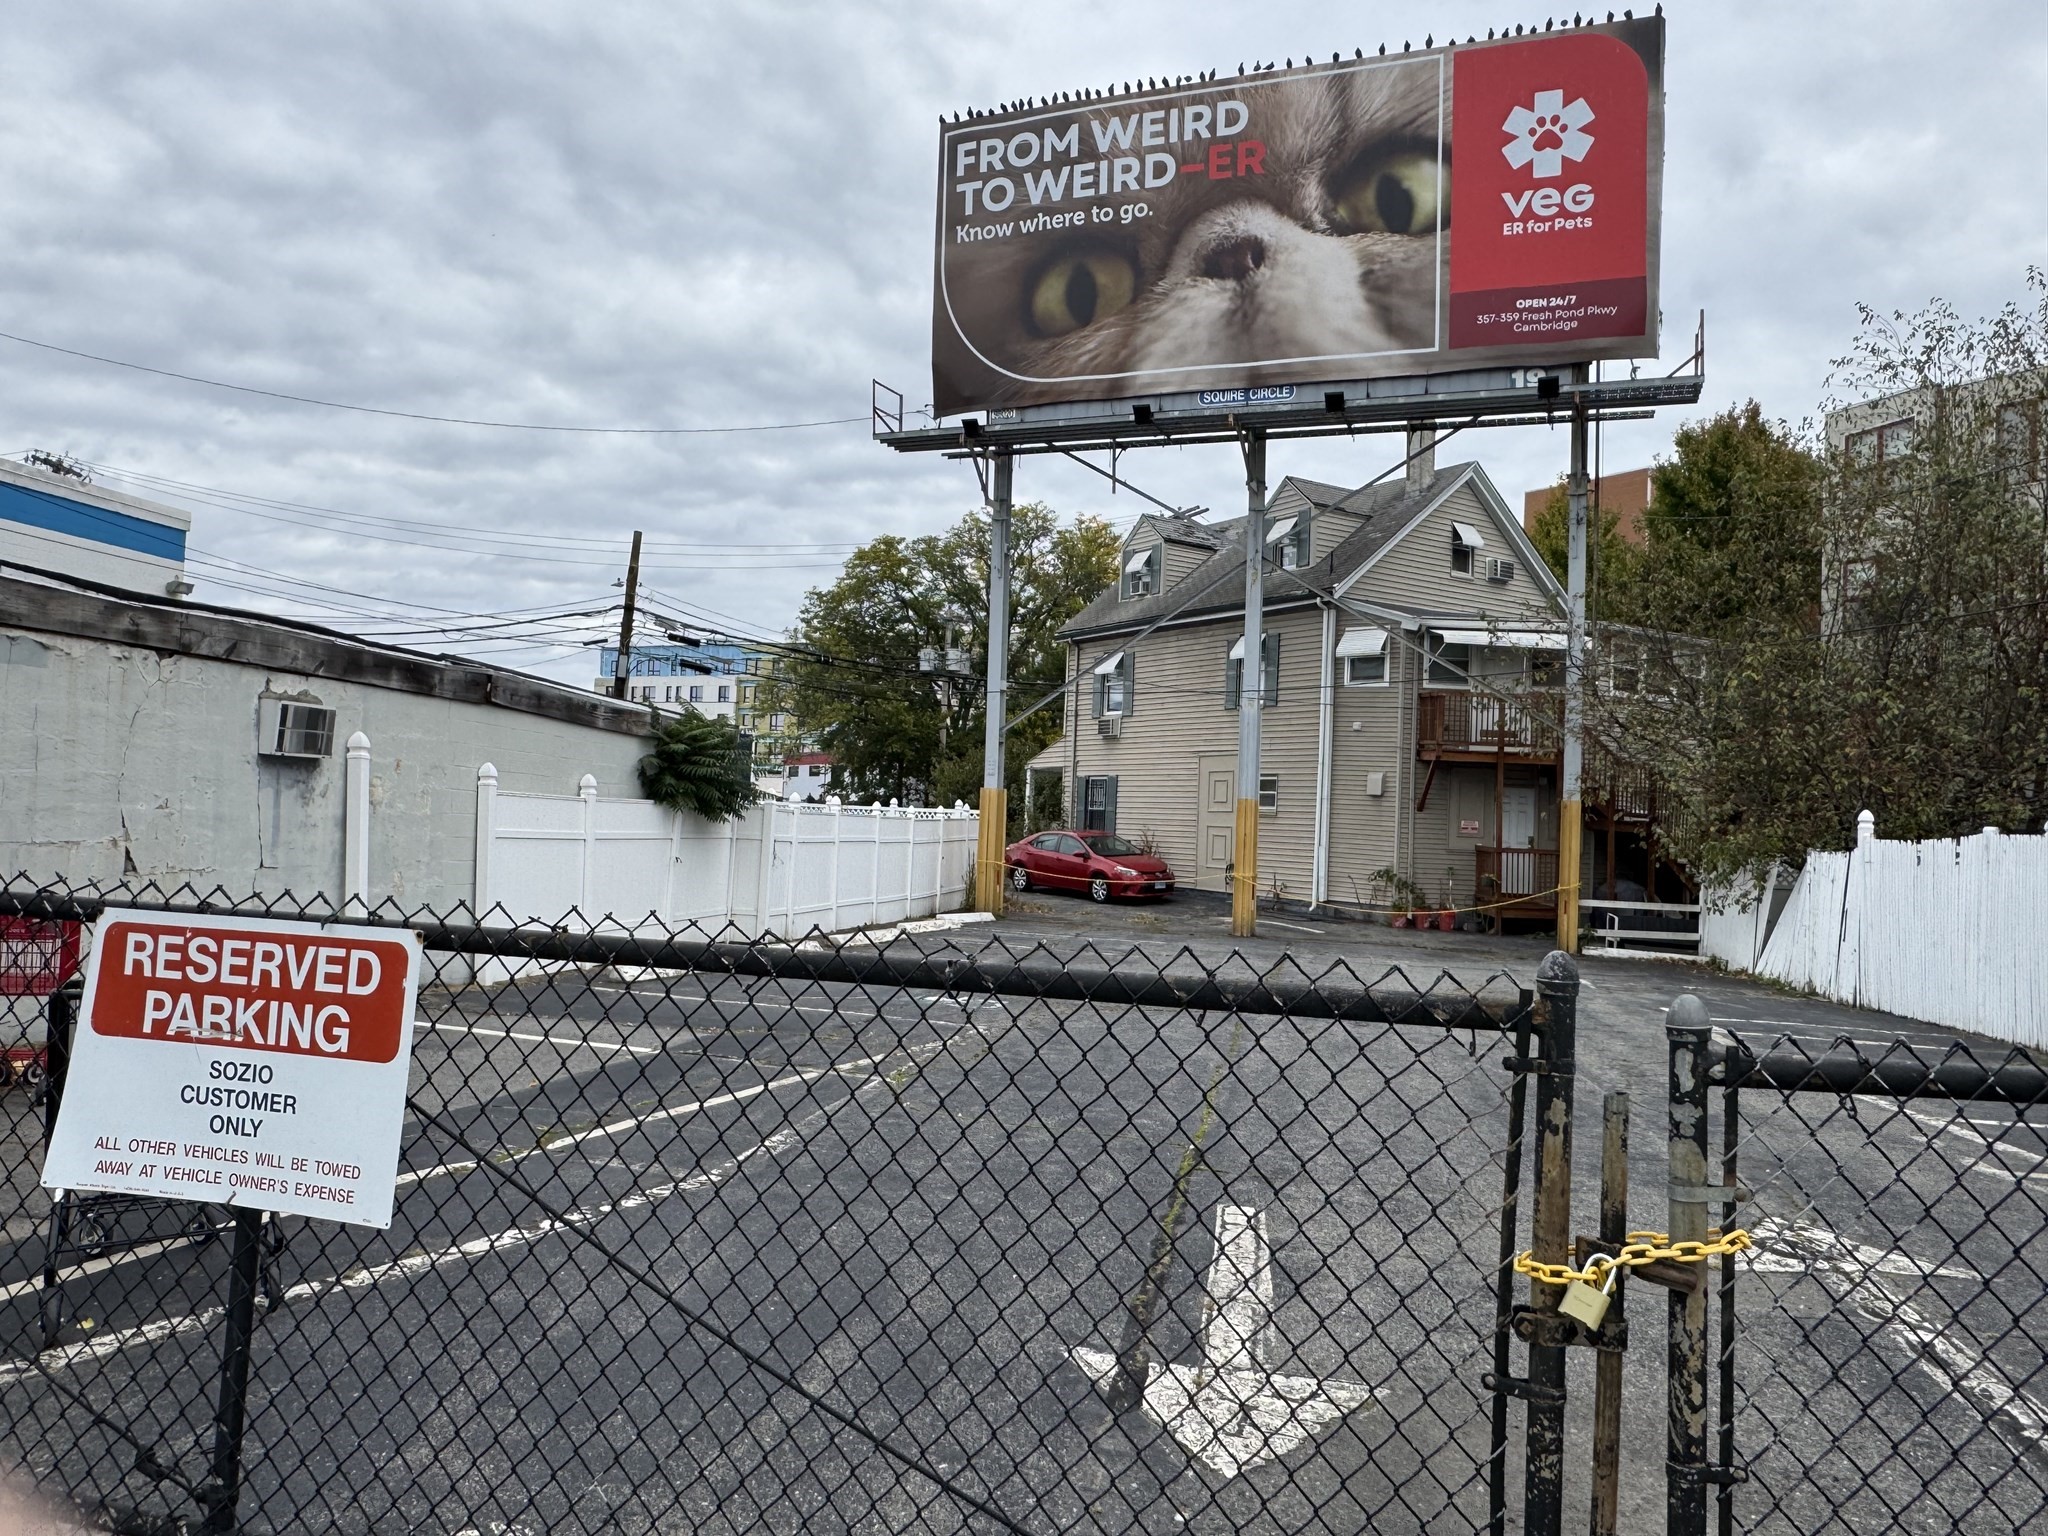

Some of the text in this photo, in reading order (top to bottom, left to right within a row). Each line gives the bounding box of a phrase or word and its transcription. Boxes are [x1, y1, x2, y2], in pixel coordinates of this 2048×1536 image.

[956, 100, 1249, 177] FROM WEIRD
[956, 140, 1267, 215] TO WEIRD-ER
[956, 202, 1153, 243] Know where to go.
[1503, 216, 1593, 235] ER for Pets
[1477, 305, 1618, 324] 357-359 Fresh Pond Pkwy
[1516, 295, 1577, 308] OPEN 24/7
[1513, 321, 1578, 332] Cambridge
[1203, 386, 1290, 403] SQUIRE CIRCLE
[124, 931, 382, 996] RESERVED
[142, 990, 351, 1054] PARKING
[209, 1060, 274, 1084] SOZIO
[180, 1084, 297, 1115] CUSTOMER
[209, 1114, 264, 1138] ONLY
[94, 1136, 362, 1180] ALL OTHER VEHICLES WILL BE TOWED
[94, 1160, 355, 1204] AWAY AT VEHICLE OWNER'S EXPENSE
